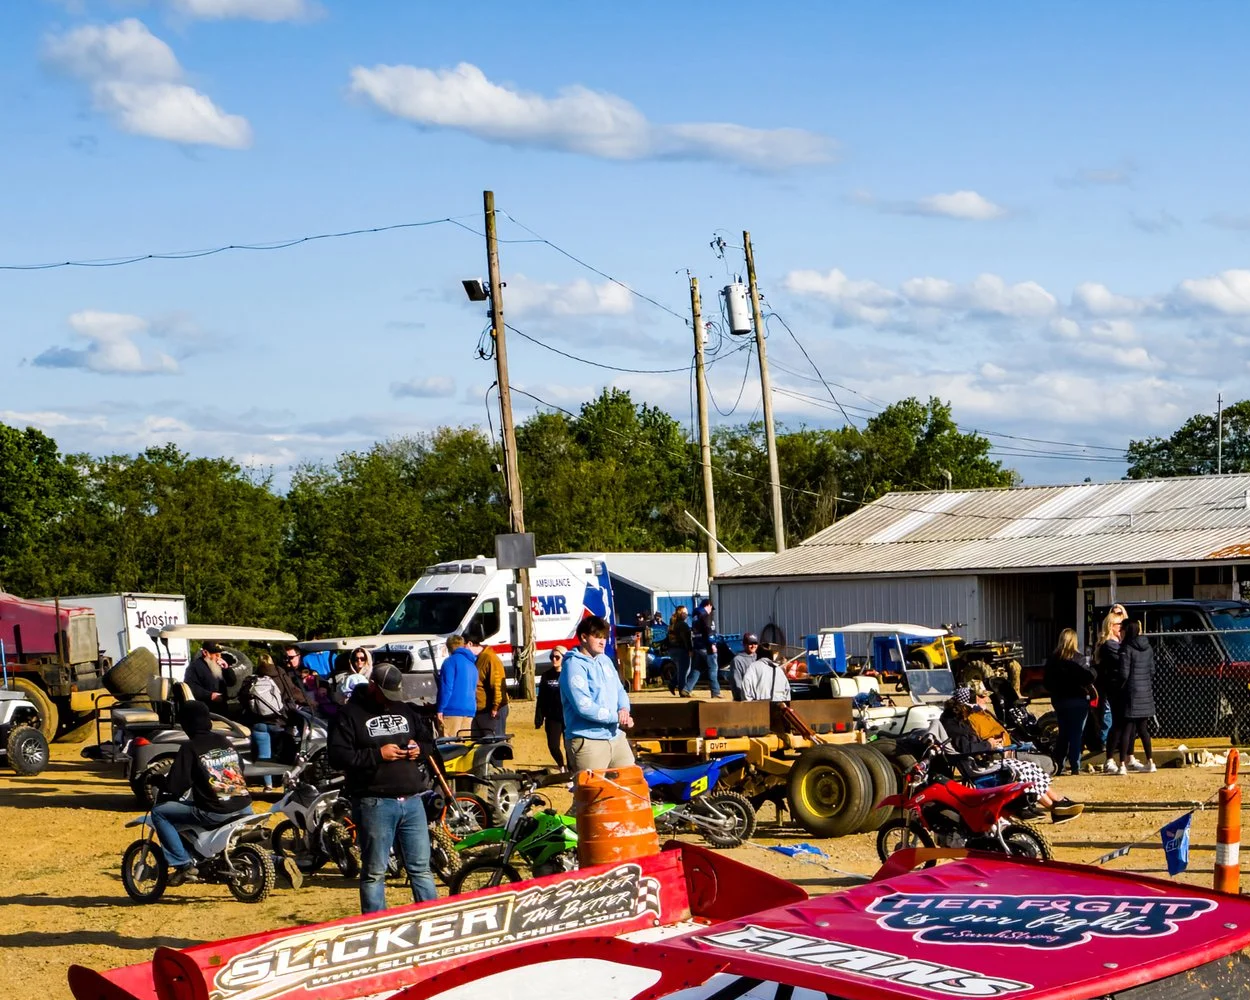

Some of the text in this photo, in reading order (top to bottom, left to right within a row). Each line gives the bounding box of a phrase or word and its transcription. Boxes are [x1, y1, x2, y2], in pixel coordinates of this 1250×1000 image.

[536, 578, 571, 587] AMBULANCE
[515, 874, 636, 912] THE SLICKER
[893, 898, 998, 909] HER
[522, 890, 632, 928] THE BETTER
[904, 912, 932, 925] is
[949, 913, 1022, 926] our
[701, 929, 1031, 996] EVANS
